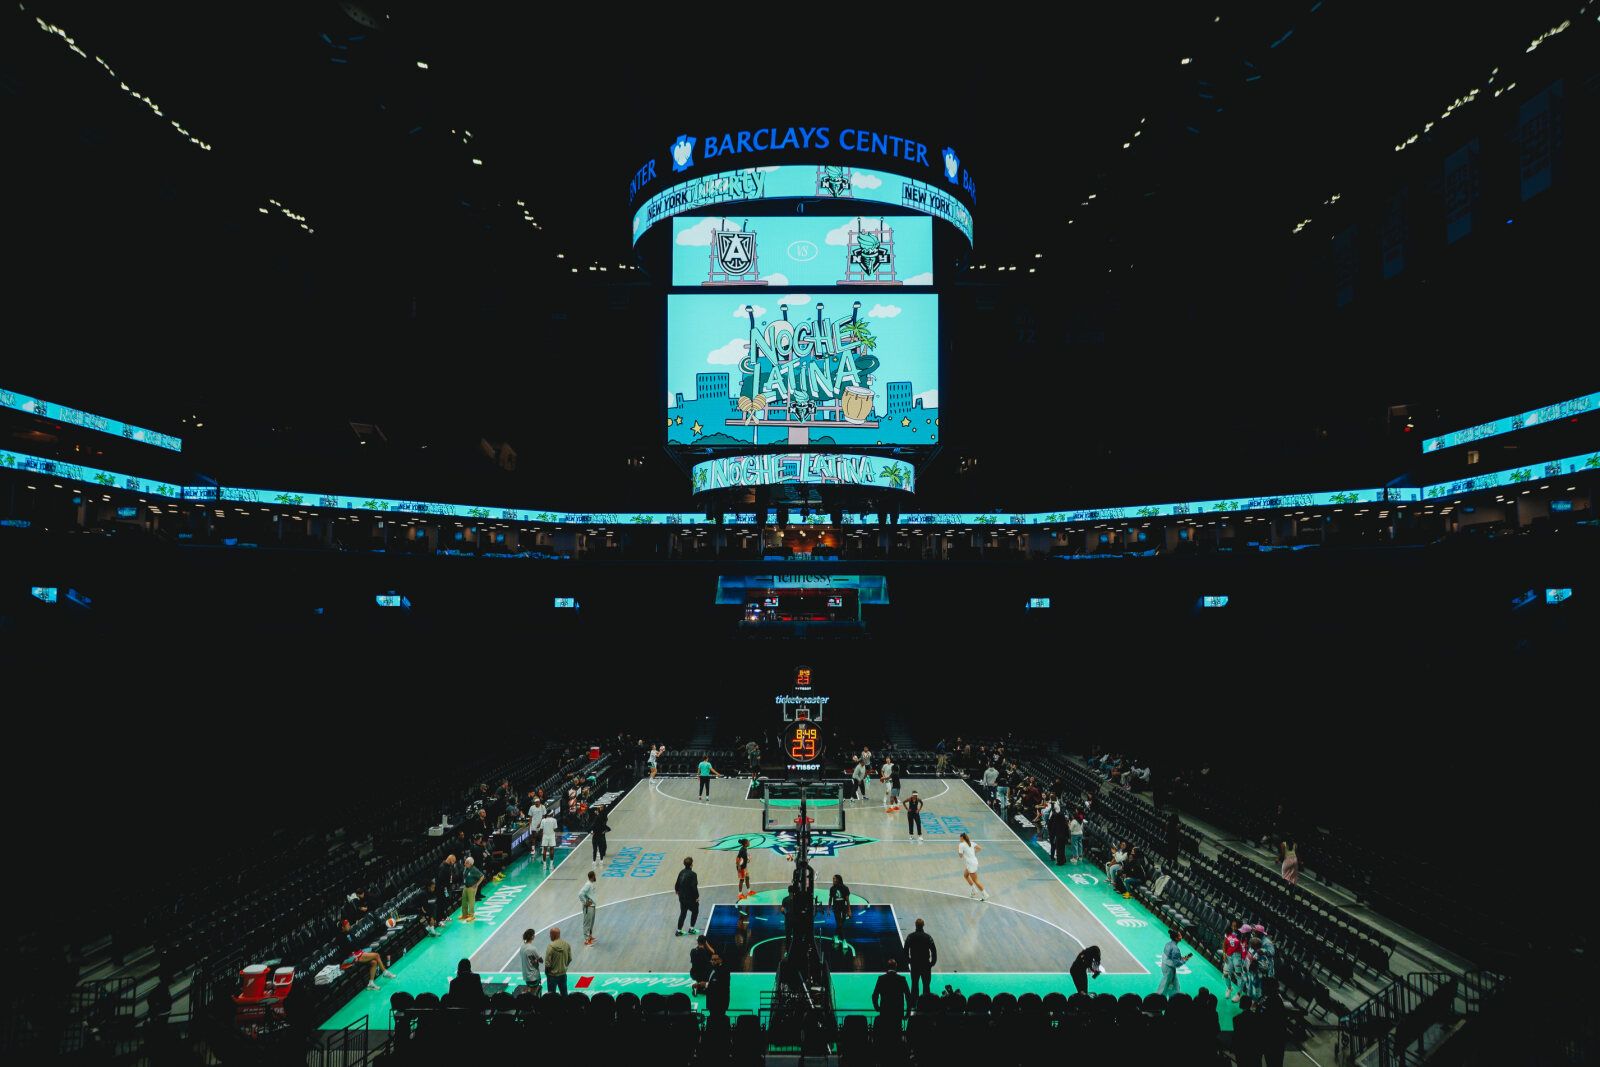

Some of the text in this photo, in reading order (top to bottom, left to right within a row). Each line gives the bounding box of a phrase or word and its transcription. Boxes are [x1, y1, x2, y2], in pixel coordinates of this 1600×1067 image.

[704, 127, 929, 167] BARCLAYS CENTER
[647, 203, 662, 219] NEW
[664, 191, 689, 212] YORK
[905, 184, 951, 216] NEW YORK
[750, 314, 863, 367] NOCHE
[711, 454, 793, 488] NOCHE
[775, 695, 830, 704] ticketmaster
[792, 740, 815, 757] 23
[796, 729, 817, 739] 8:49
